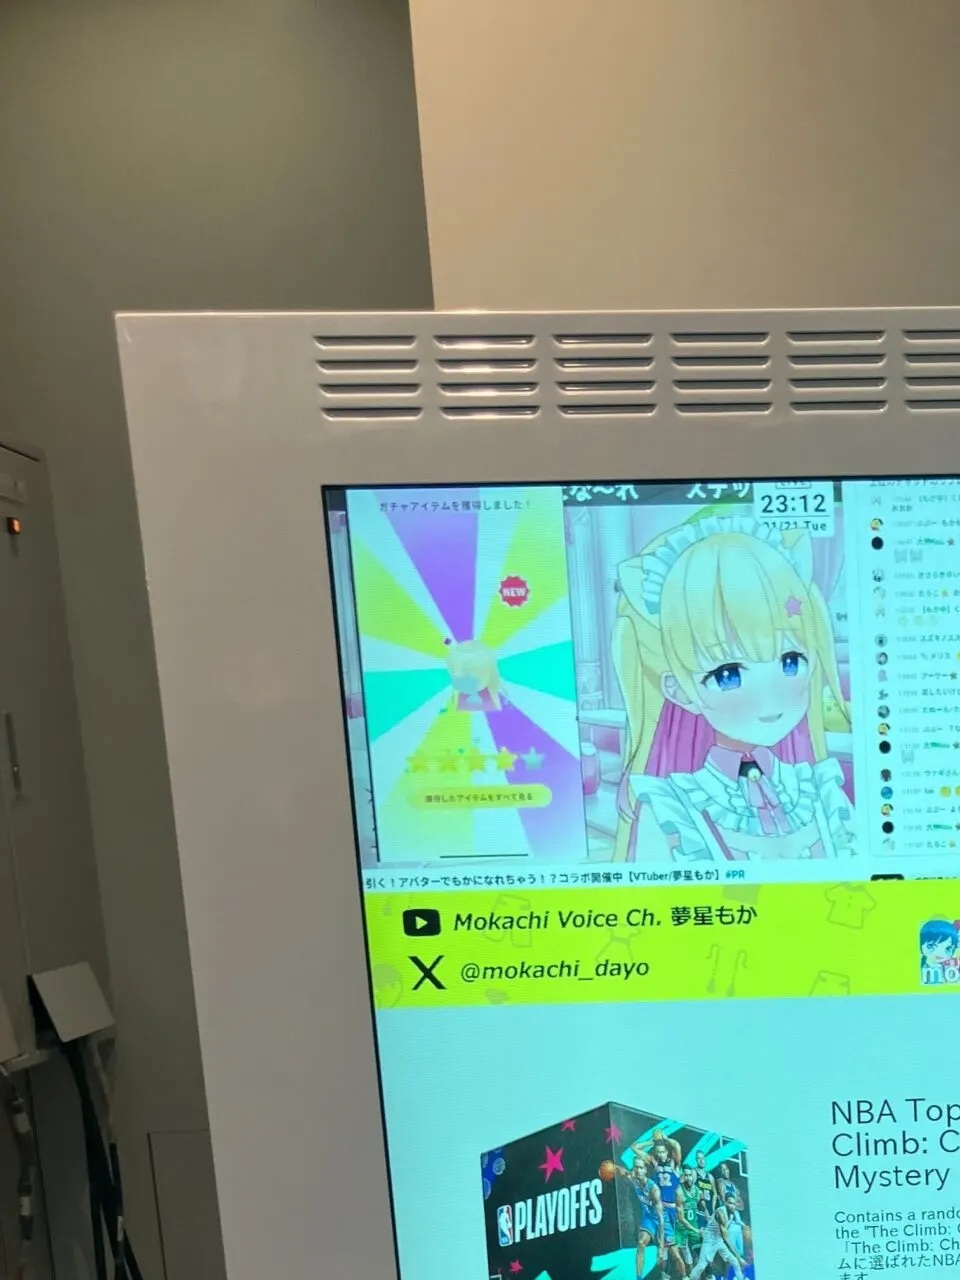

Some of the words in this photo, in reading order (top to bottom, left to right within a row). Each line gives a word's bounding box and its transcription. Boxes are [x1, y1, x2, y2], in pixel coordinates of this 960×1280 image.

[761, 494, 827, 513] 23:12
[803, 520, 828, 531] Tue
[453, 910, 549, 931] Mokachi
[558, 908, 618, 928] Voice
[626, 908, 661, 928] Ch.
[671, 905, 757, 926] 夢星もか
[461, 959, 650, 983] @mokachi_dayo
[831, 1100, 897, 1125] NBA
[832, 1130, 928, 1157] Climb:
[834, 1164, 950, 1194] Mystery
[514, 1178, 603, 1243] PLAYOFFS
[834, 1209, 902, 1224] Contains
[907, 1212, 916, 1221] a
[835, 1226, 860, 1240] the
[864, 1224, 899, 1238] "The
[903, 1223, 952, 1237] Climb:
[844, 1240, 882, 1255] 「The
[885, 1238, 934, 1253] Climb:
